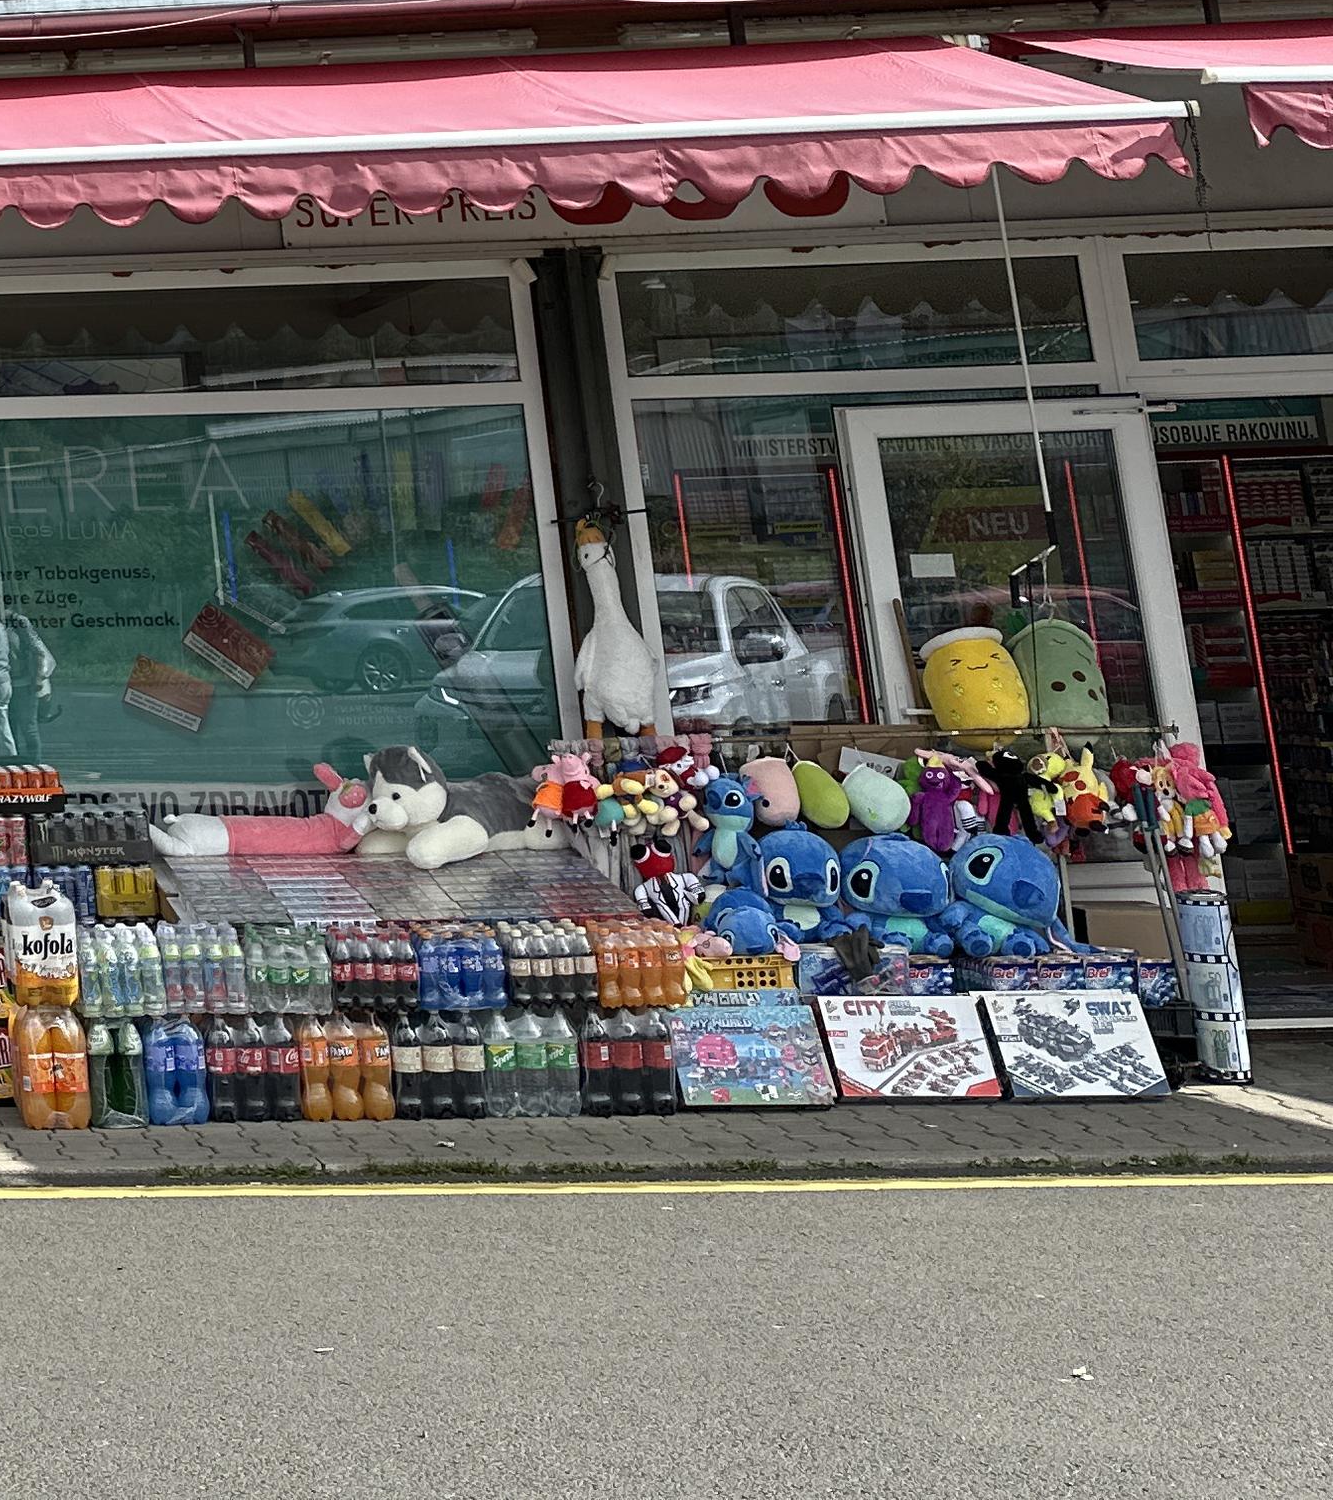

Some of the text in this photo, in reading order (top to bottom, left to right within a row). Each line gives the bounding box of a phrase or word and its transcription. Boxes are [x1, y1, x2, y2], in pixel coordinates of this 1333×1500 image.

[967, 510, 1031, 538] NEU
[34, 564, 157, 583] Tabakgenuss,
[35, 589, 84, 607] Züge,
[71, 612, 181, 630] Geschmack.
[190, 789, 331, 818] ZDRAVOT
[67, 846, 125, 858] MONSTER
[22, 932, 74, 961] kofola
[992, 966, 1018, 979] Bref
[1039, 966, 1064, 979] Bref
[1086, 965, 1113, 978] Bref
[843, 1000, 887, 1017] CITY
[1085, 1001, 1132, 1017] SWAT
[713, 1018, 753, 1029] WORLD
